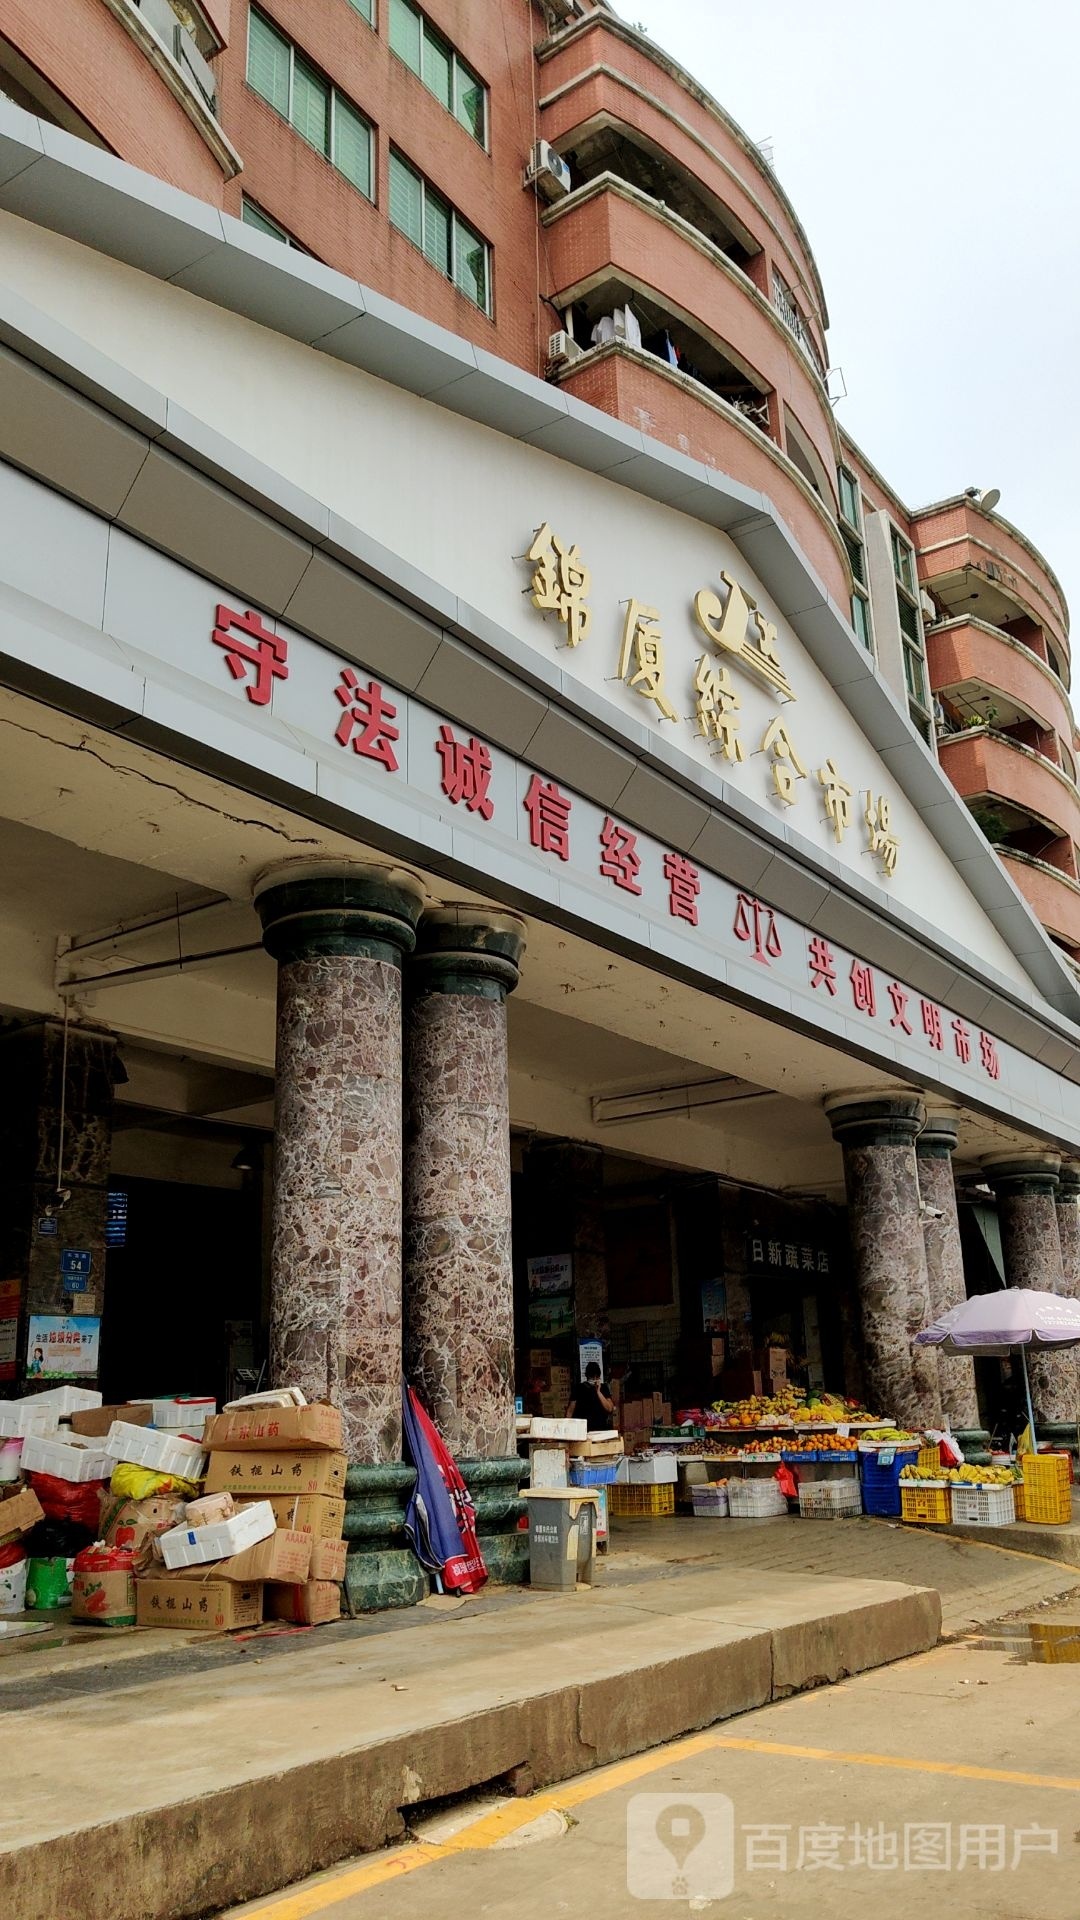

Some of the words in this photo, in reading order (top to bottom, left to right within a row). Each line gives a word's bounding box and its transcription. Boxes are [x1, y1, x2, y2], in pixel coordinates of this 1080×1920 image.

[211, 603, 701, 926] 守法诚信经营
[808, 937, 1001, 1080] 共创文明市场
[71, 1260, 83, 1271] 54
[307, 1480, 318, 1492] 80
[214, 1614, 225, 1626] 80
